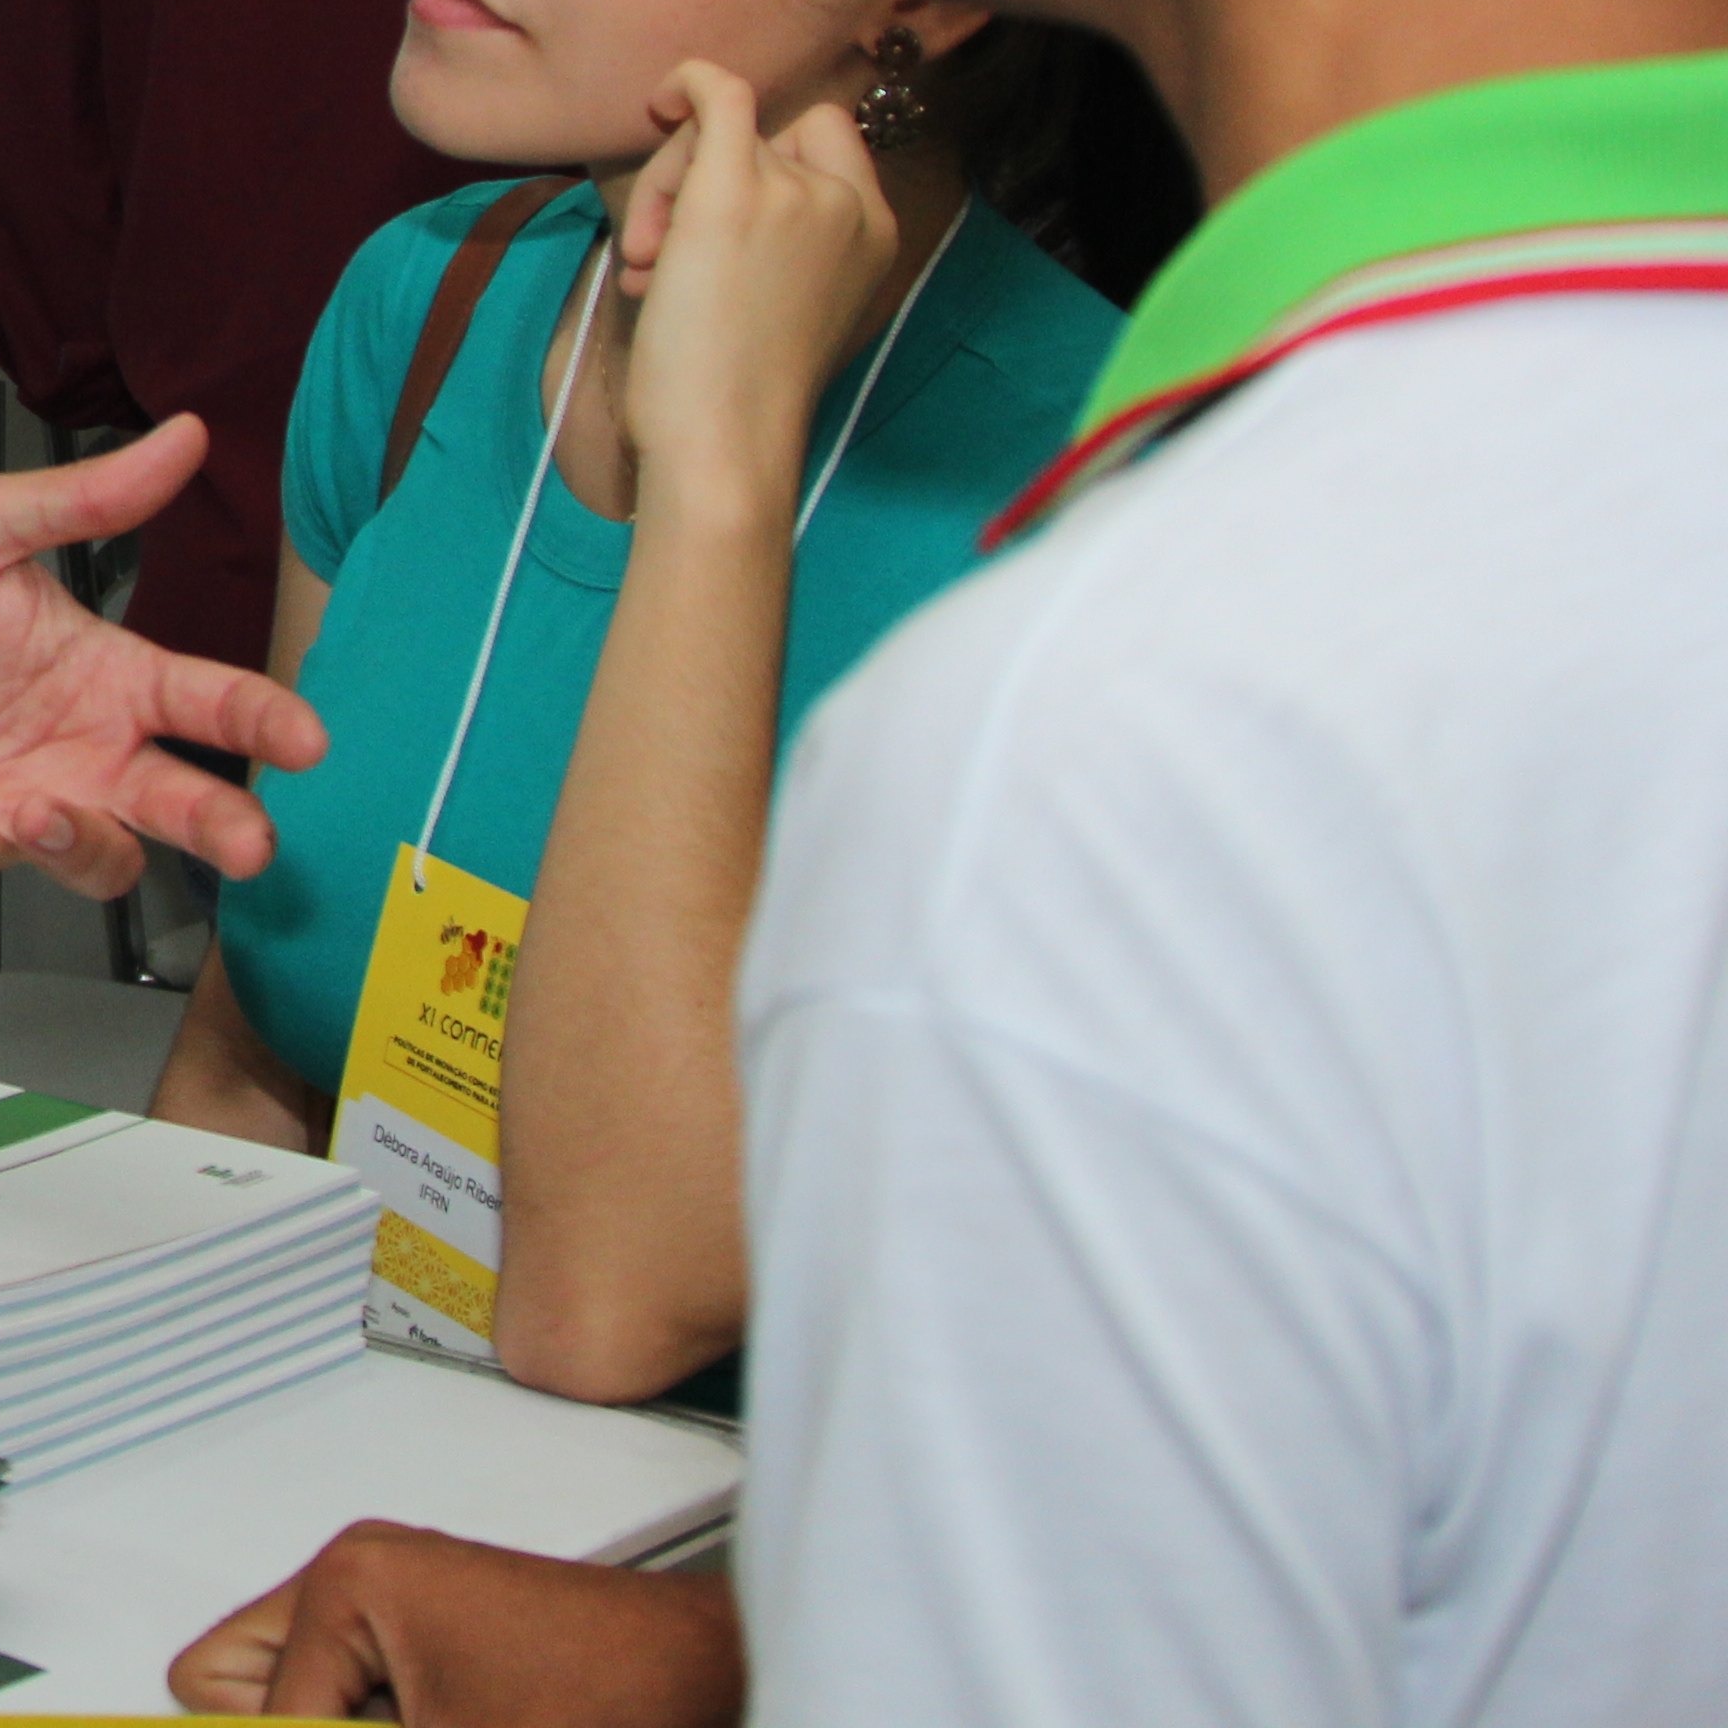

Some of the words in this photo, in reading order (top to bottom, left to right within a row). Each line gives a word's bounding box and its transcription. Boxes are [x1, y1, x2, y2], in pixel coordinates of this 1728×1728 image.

[418, 1001, 437, 1028] XI
[373, 1123, 420, 1166] Débora
[420, 1152, 463, 1192] Araújo
[419, 1182, 451, 1215] IFRN
